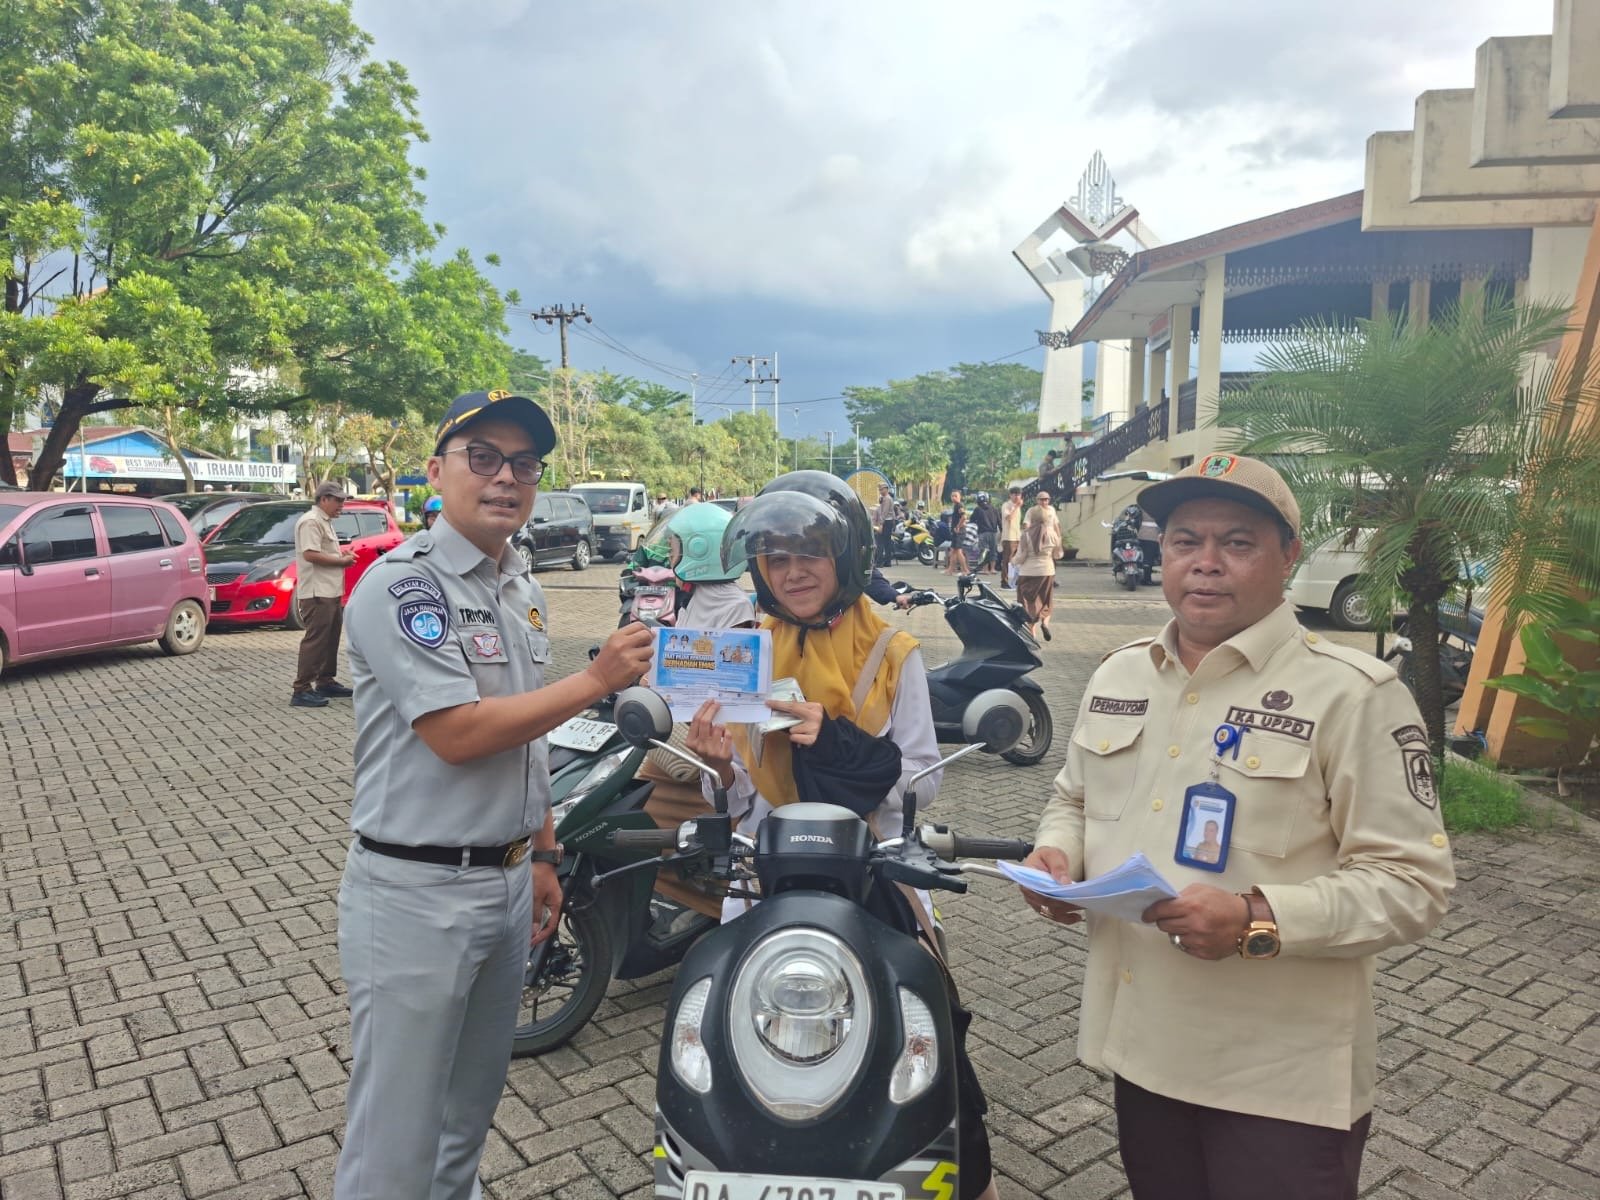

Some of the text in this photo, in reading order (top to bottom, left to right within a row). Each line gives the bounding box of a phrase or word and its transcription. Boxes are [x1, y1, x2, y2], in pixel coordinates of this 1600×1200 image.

[125, 458, 142, 467] BEST
[207, 462, 245, 477] IRHAM
[403, 606, 419, 616] JASA
[1234, 710, 1305, 735] KA UPPD
[575, 821, 609, 843] HONDA
[789, 834, 834, 845] HONDA
